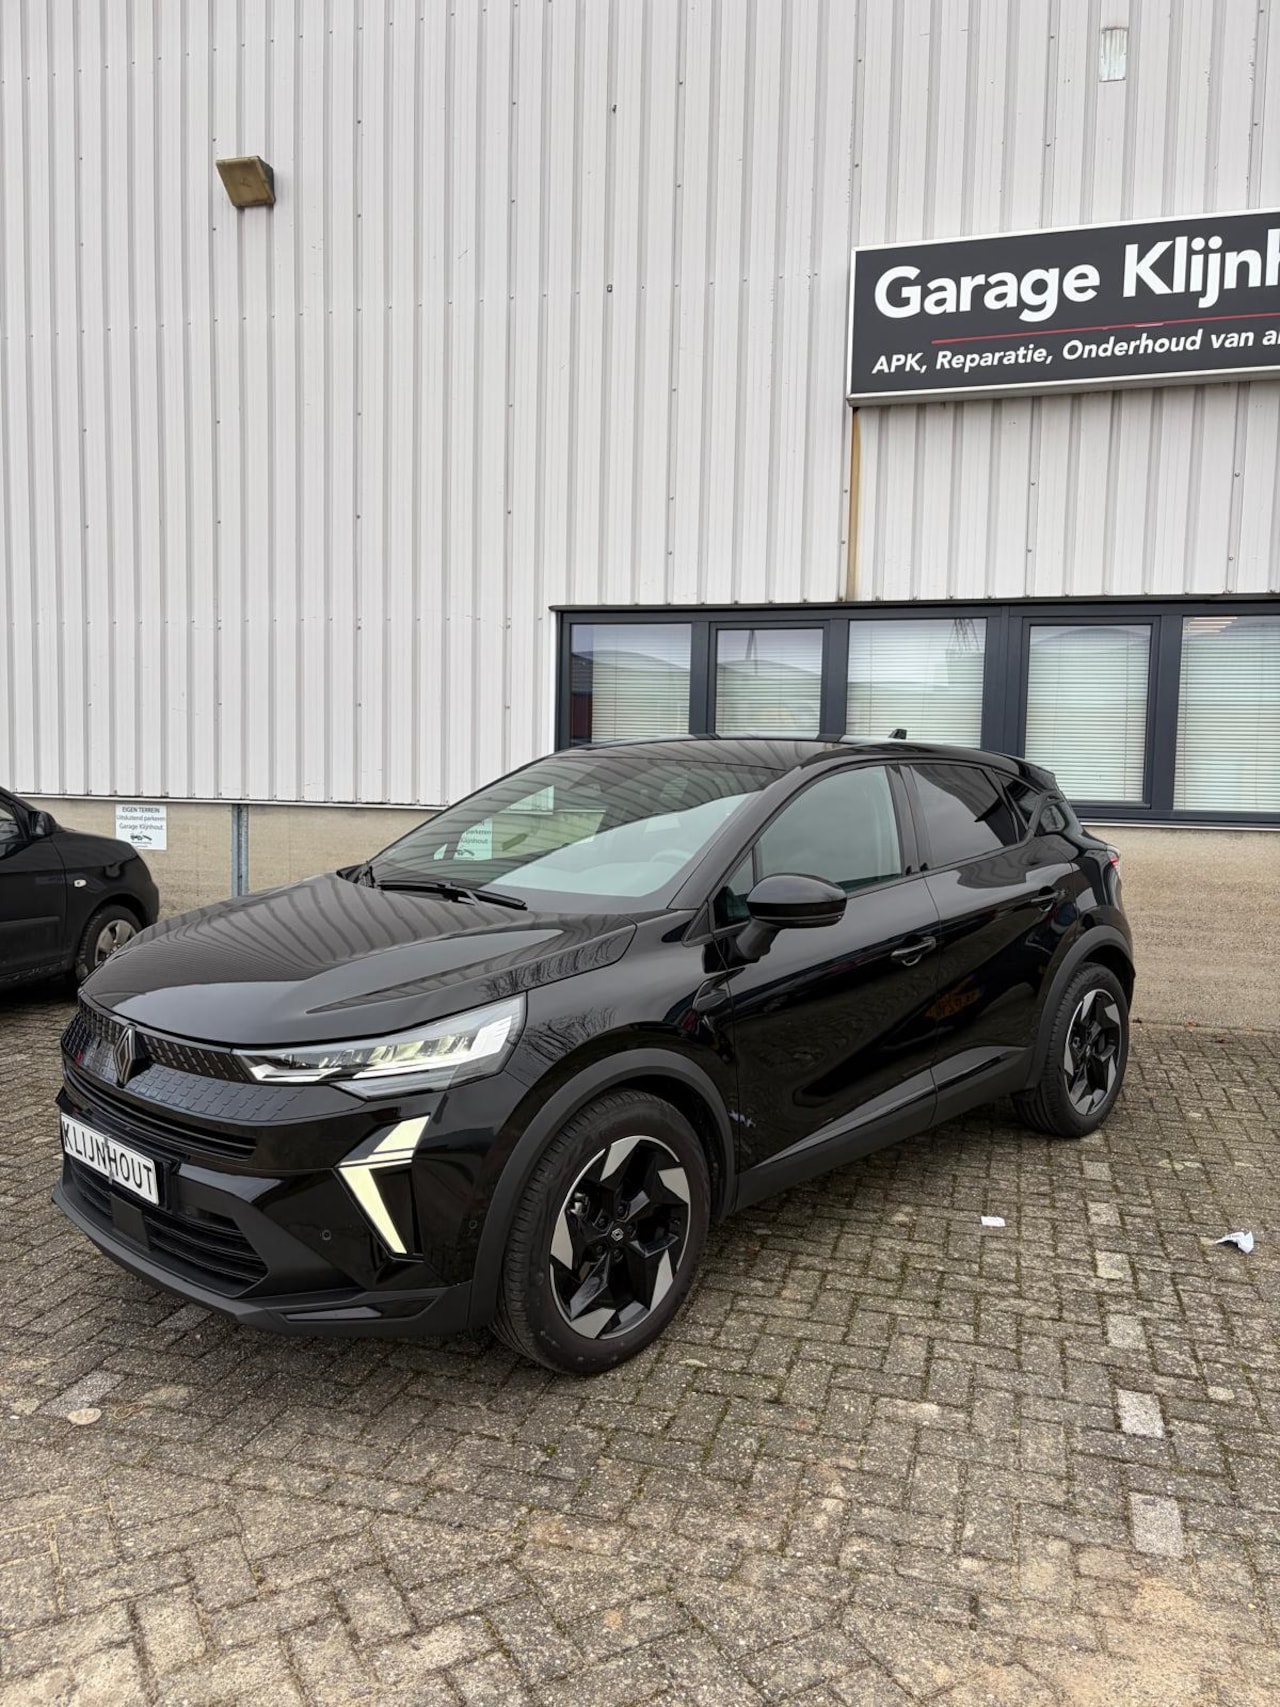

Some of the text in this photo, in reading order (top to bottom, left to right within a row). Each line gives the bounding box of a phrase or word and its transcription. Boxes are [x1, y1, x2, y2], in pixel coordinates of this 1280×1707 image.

[874, 263, 1101, 323] Garage
[871, 329, 1280, 374] APK, Reparatie, Onderhoud van a
[119, 822, 138, 830] Garage
[62, 1120, 152, 1196] KLIJNHOUT
